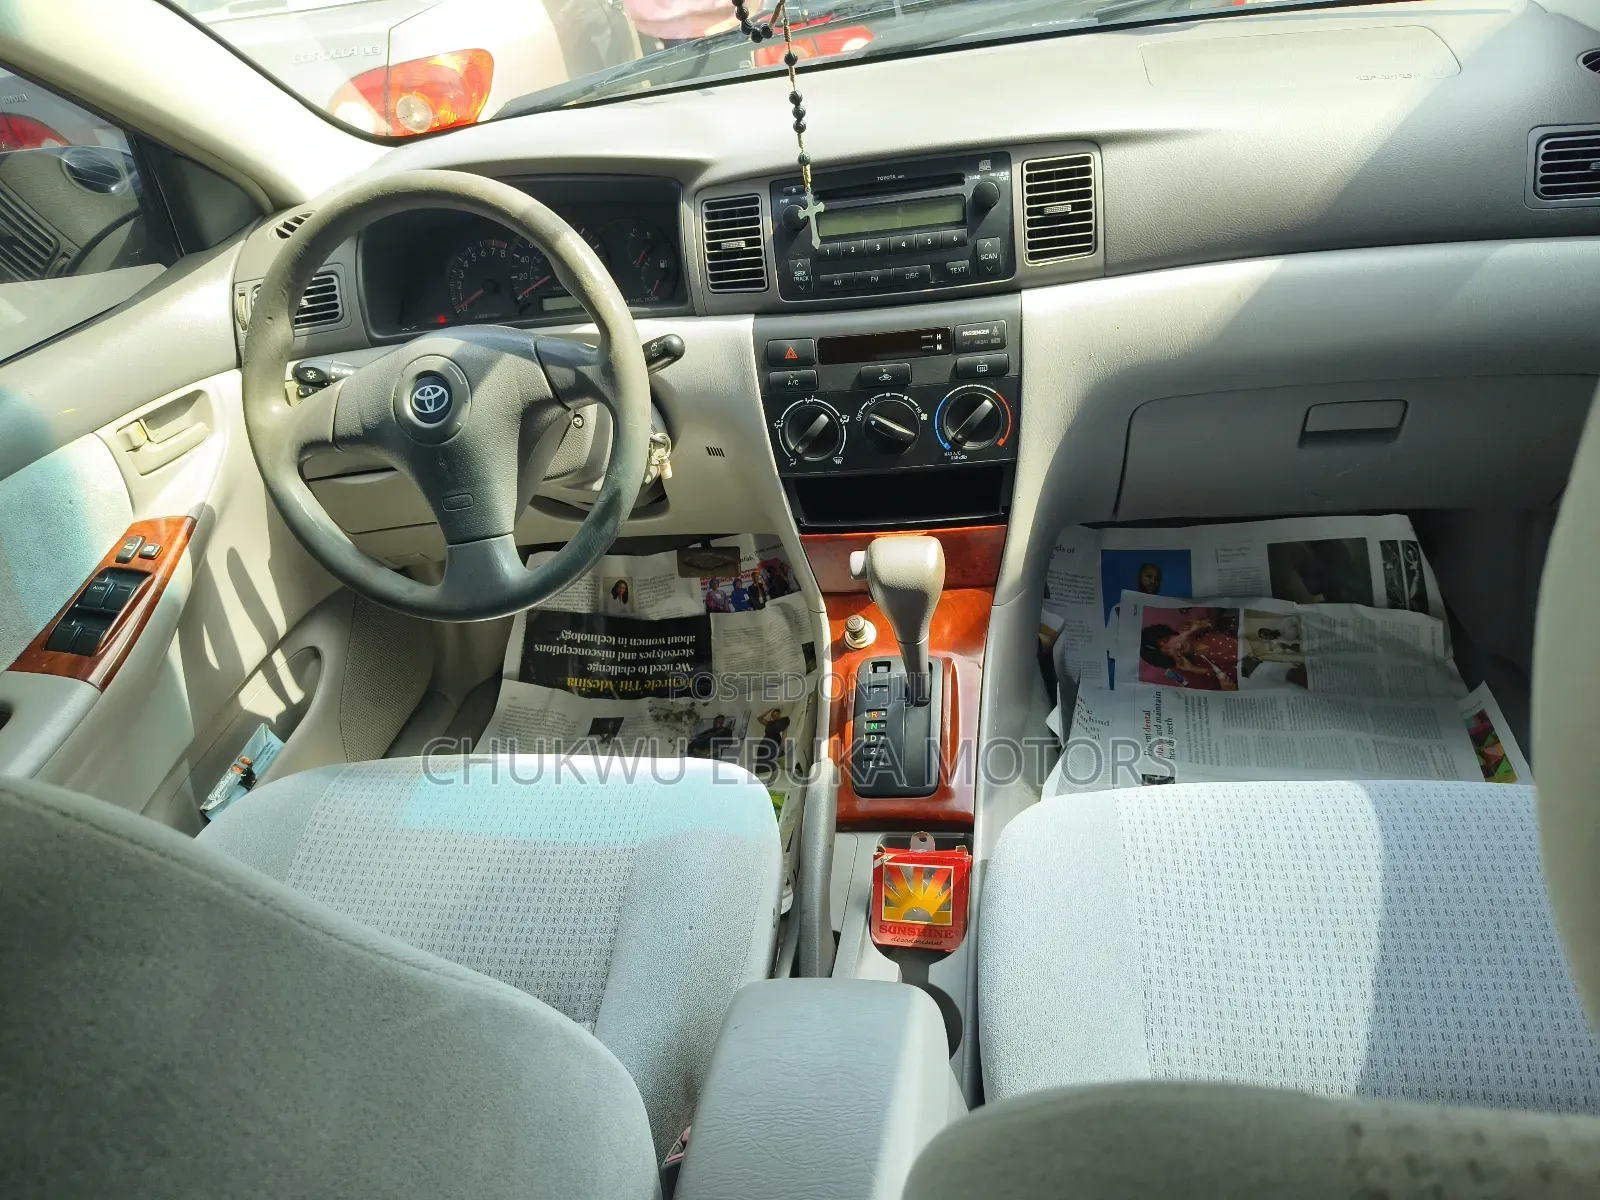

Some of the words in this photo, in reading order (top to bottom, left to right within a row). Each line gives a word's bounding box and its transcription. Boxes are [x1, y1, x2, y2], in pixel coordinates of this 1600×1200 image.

[292, 46, 358, 64] COROLLA
[362, 45, 382, 57] LE
[950, 266, 966, 274] TEXT
[867, 397, 876, 406] LO
[856, 409, 864, 422] OFF
[618, 638, 628, 648] in
[630, 637, 666, 647] women
[668, 635, 696, 644] about
[534, 643, 615, 660] misconceptions
[618, 652, 637, 661] and
[639, 648, 695, 659] stereotypes
[587, 663, 635, 676] challenge
[638, 664, 648, 674] to
[650, 662, 673, 674] need
[567, 677, 614, 691] Adesina
[619, 677, 642, 690] Titi
[1154, 691, 1162, 725] maintain
[1143, 709, 1151, 731] dental
[1165, 718, 1174, 735] teeth
[879, 924, 954, 939] SUNSHINE
